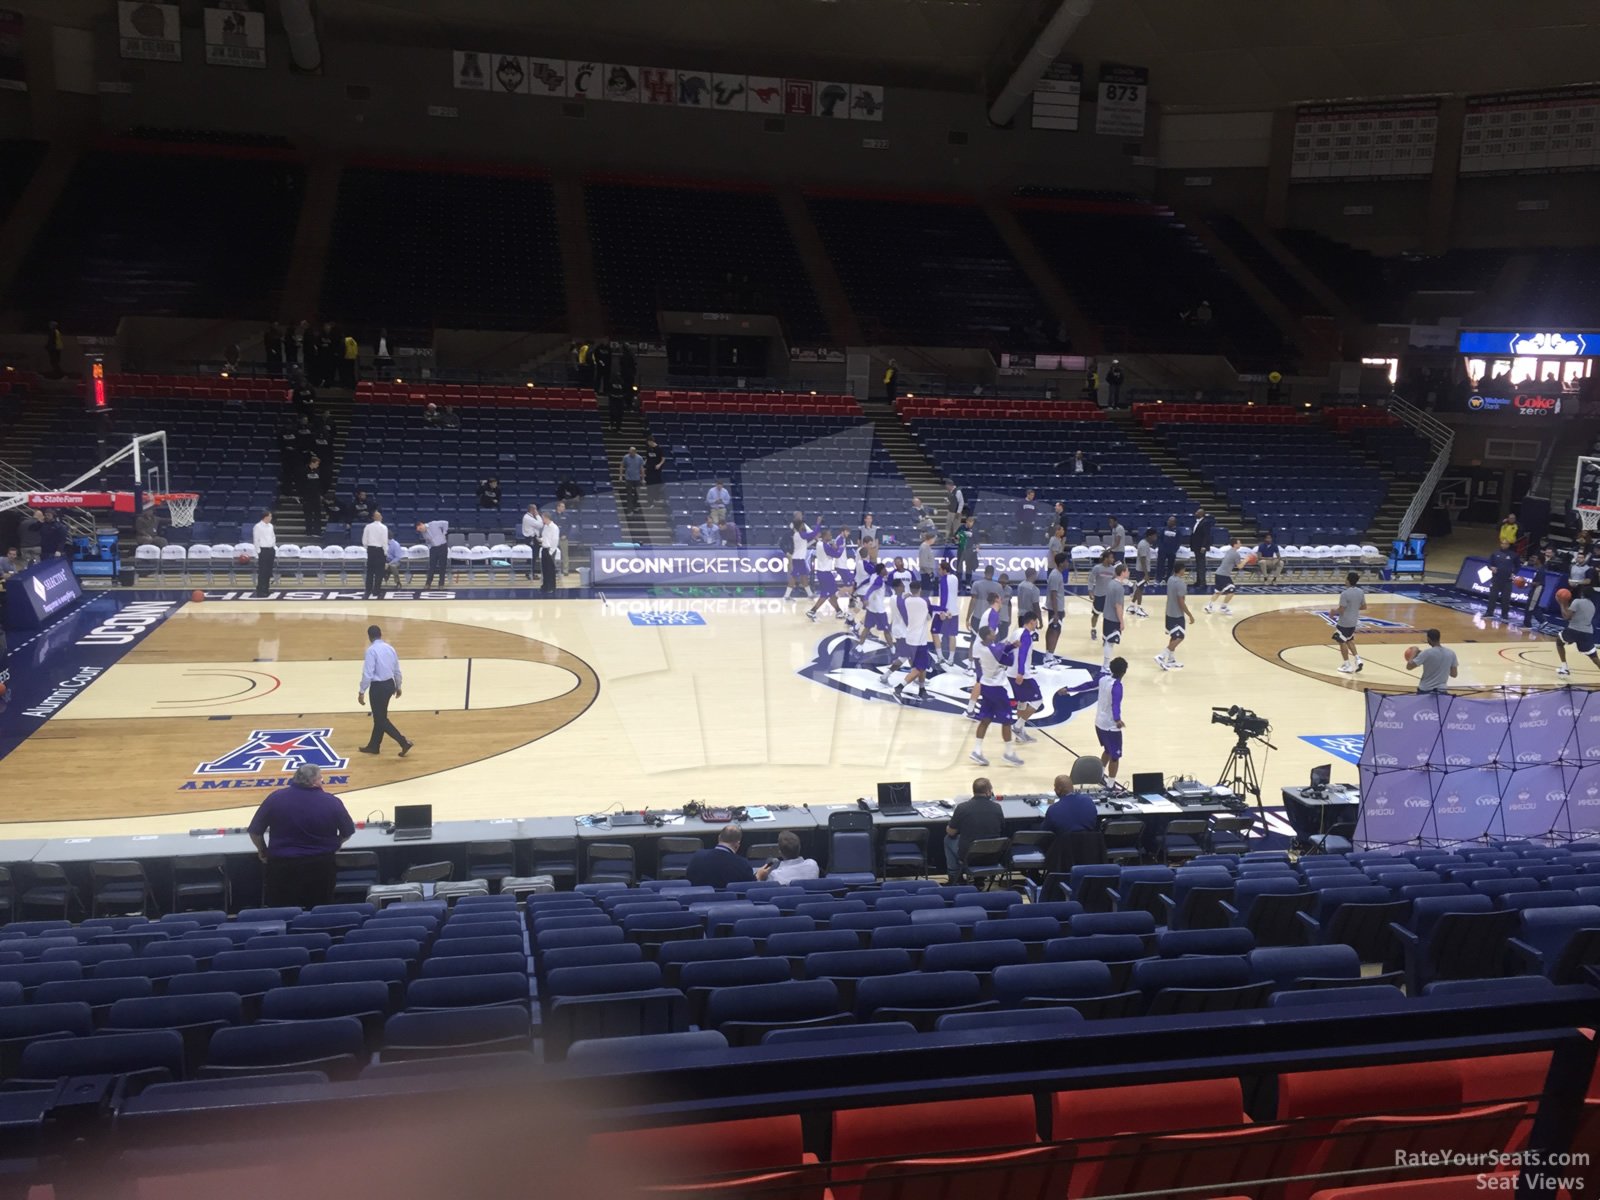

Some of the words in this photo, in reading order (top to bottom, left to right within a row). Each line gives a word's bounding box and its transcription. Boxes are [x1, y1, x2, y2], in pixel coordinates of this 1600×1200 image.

[1106, 85, 1138, 101] 873
[1514, 394, 1555, 409] Coke
[1520, 408, 1548, 416] zero
[75, 601, 177, 645] UCONN
[22, 688, 82, 718] Alumni
[63, 665, 103, 687] Court
